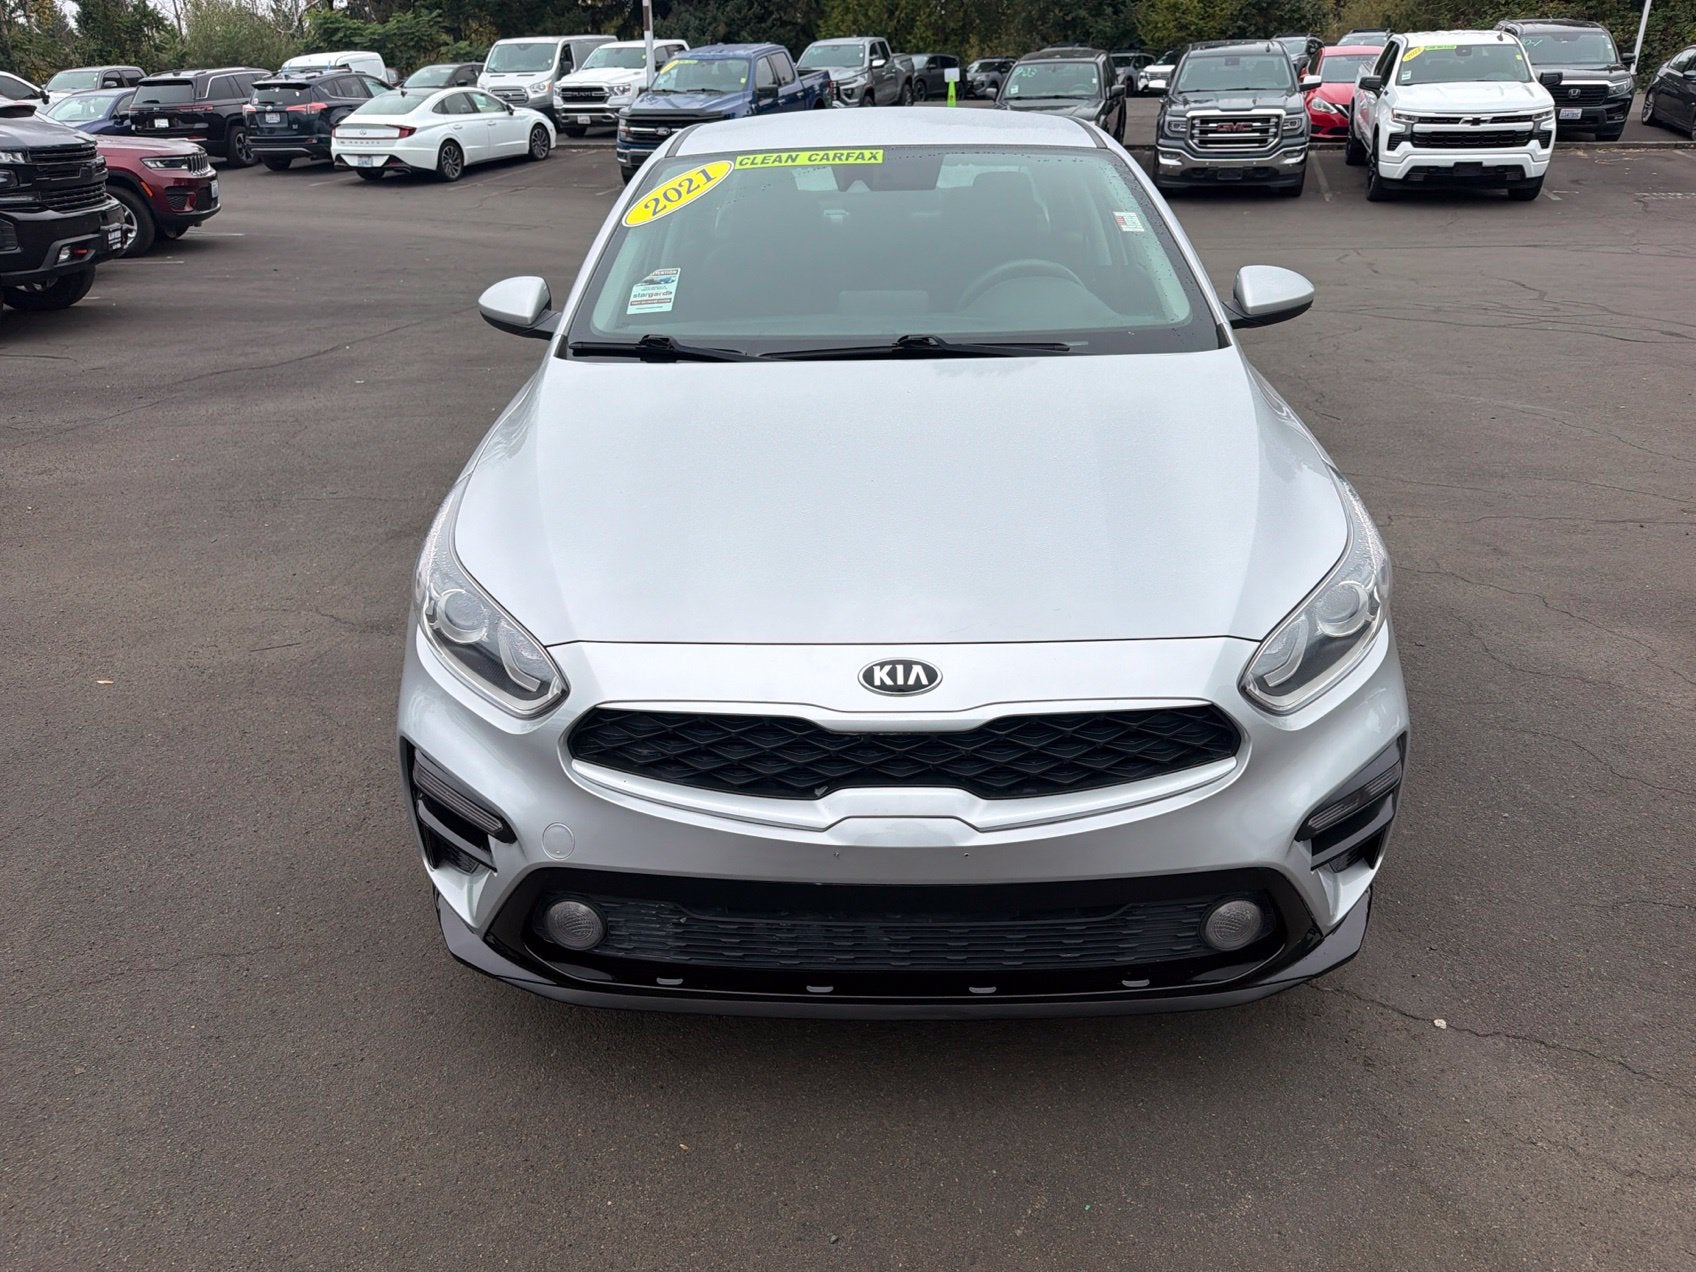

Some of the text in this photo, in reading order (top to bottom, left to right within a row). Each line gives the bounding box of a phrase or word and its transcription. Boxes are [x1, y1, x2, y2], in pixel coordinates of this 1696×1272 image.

[1216, 121, 1253, 132] GMC
[738, 151, 880, 167] CLEAN CARFAX
[644, 168, 717, 216] 2021
[872, 664, 929, 687] KIA
